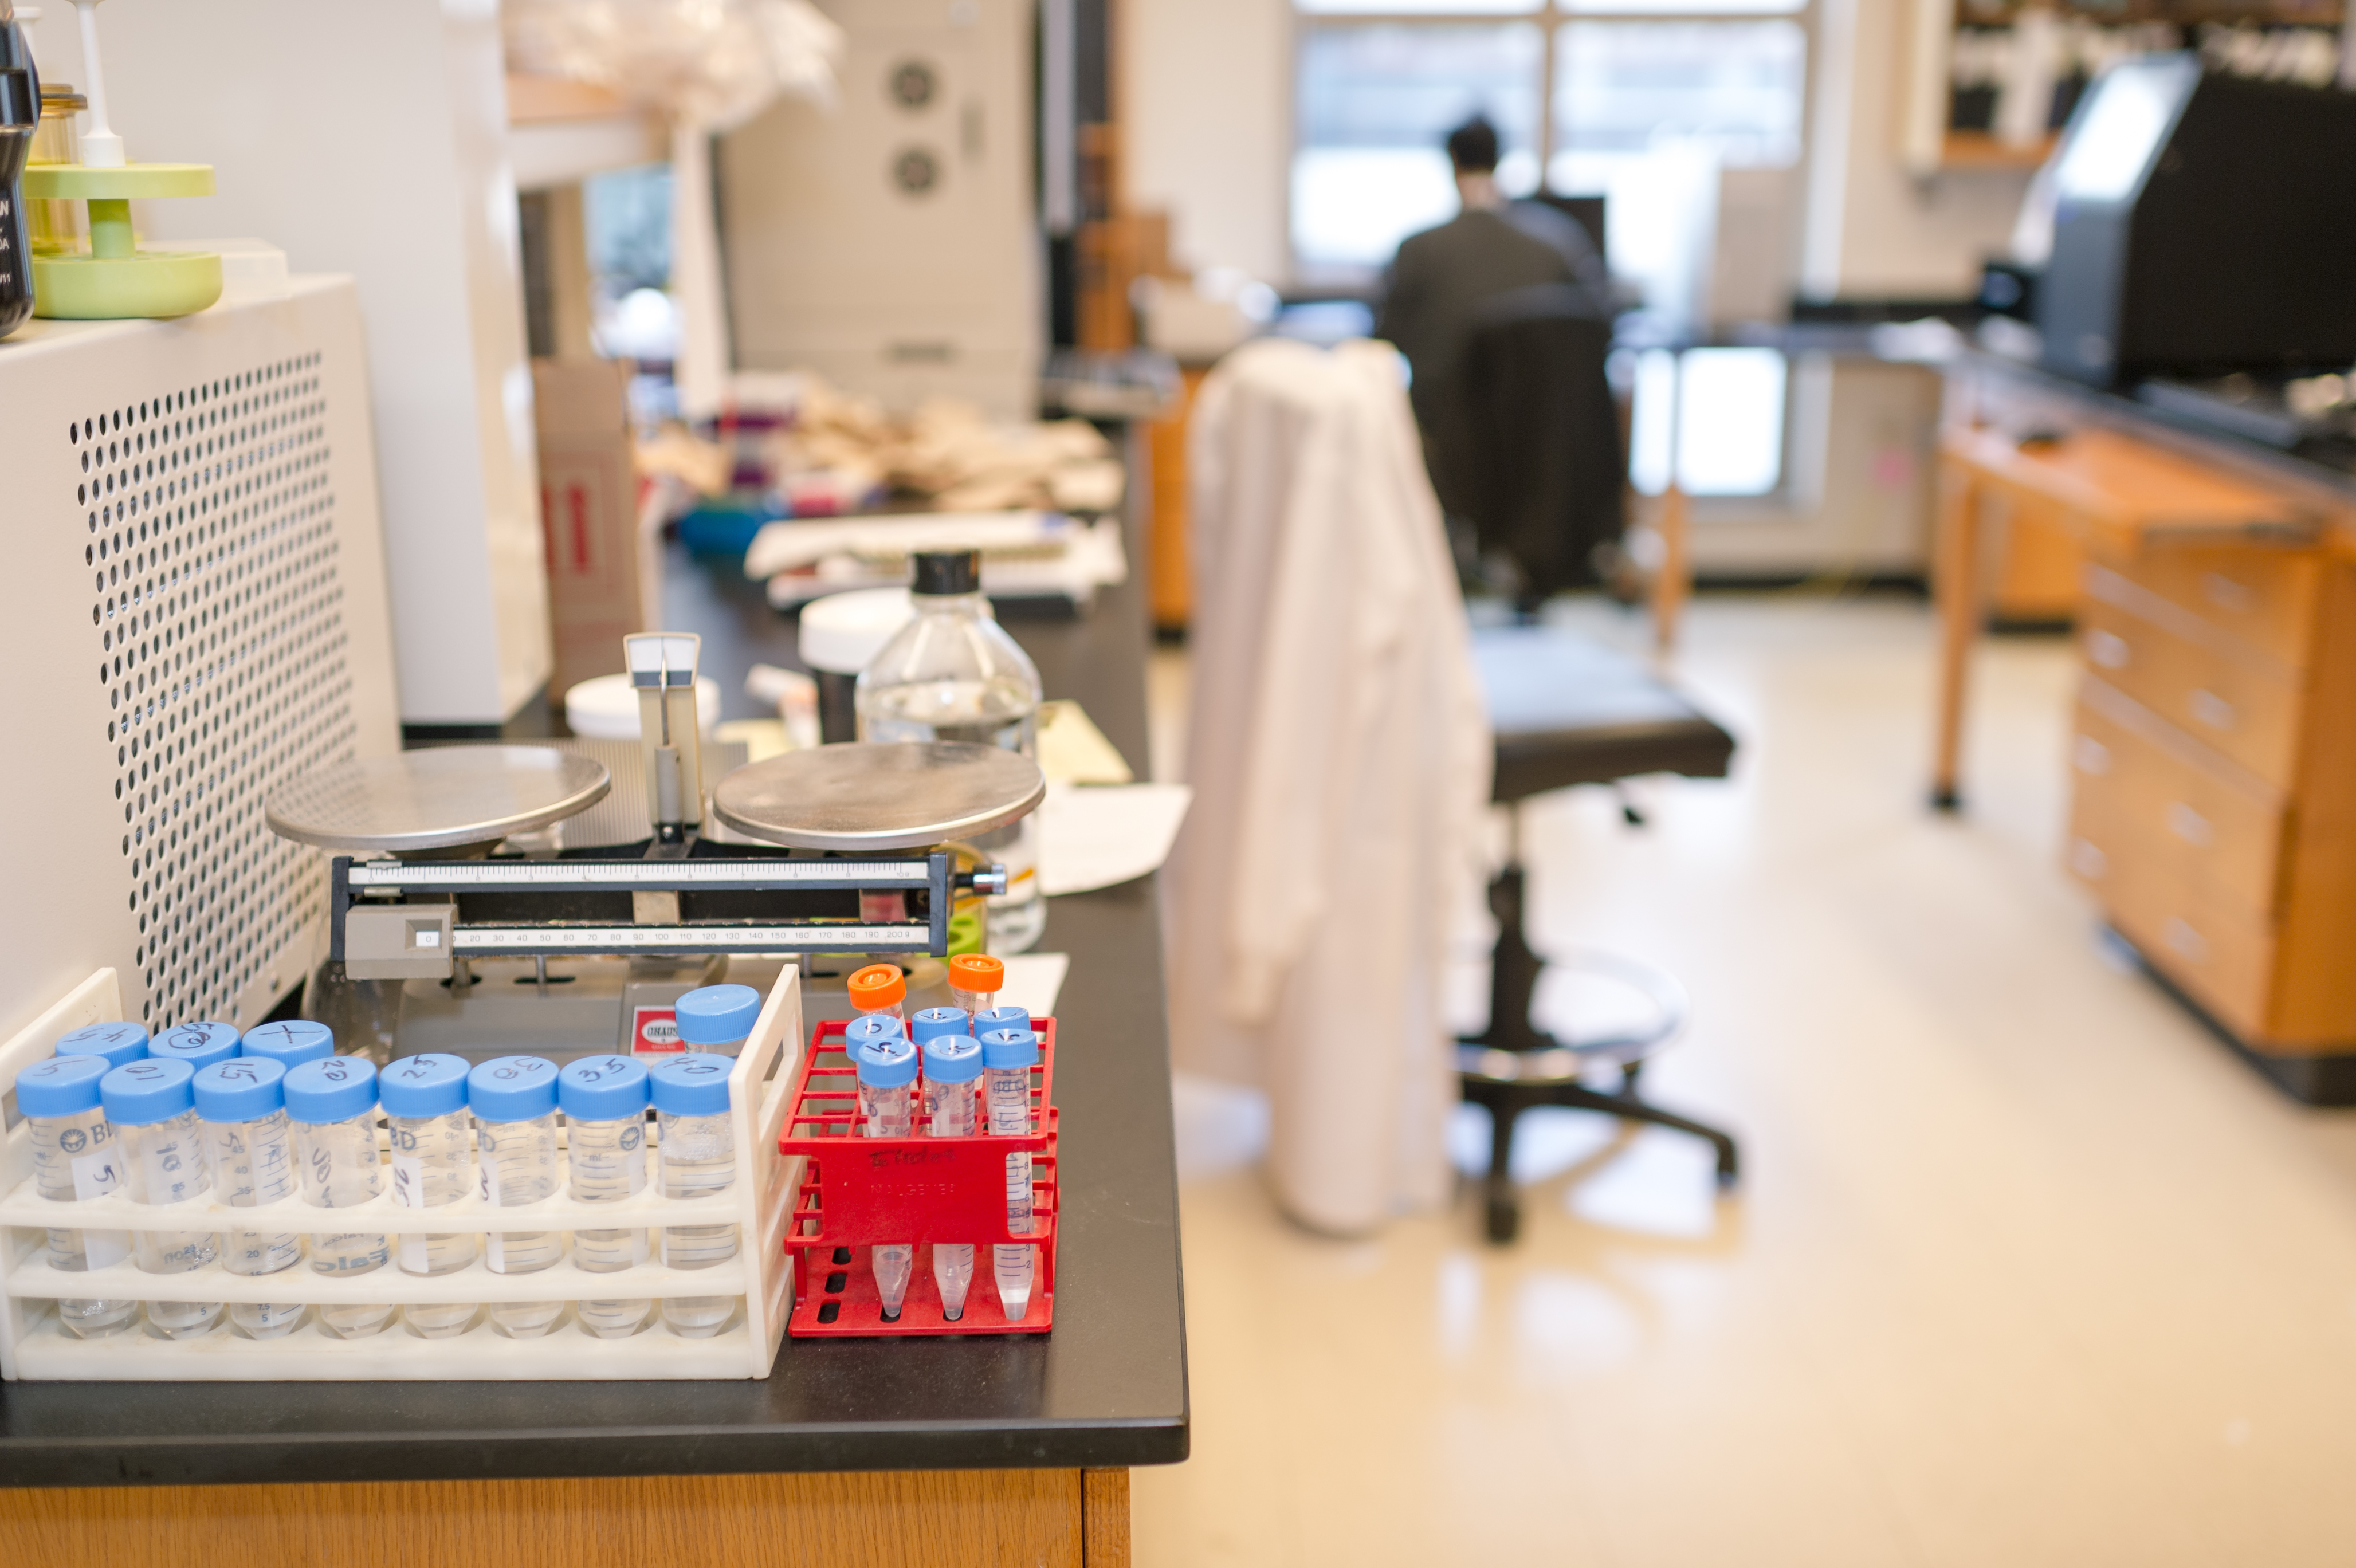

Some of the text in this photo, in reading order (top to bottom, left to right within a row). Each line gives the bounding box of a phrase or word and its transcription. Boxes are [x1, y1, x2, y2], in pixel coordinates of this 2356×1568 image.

[647, 1026, 678, 1037] OHAUS
[578, 1058, 626, 1082] 35
[232, 1145, 245, 1154] 45
[588, 1153, 602, 1162] ml
[235, 1166, 248, 1174] 40
[1024, 1162, 1029, 1170] 8
[237, 1186, 251, 1195] 35
[1024, 1194, 1030, 1202] 6
[1025, 1244, 1031, 1252] 3
[246, 1249, 260, 1259] 20
[1026, 1260, 1031, 1268] 2
[201, 1307, 207, 1316] 5
[261, 1314, 269, 1322] 5
